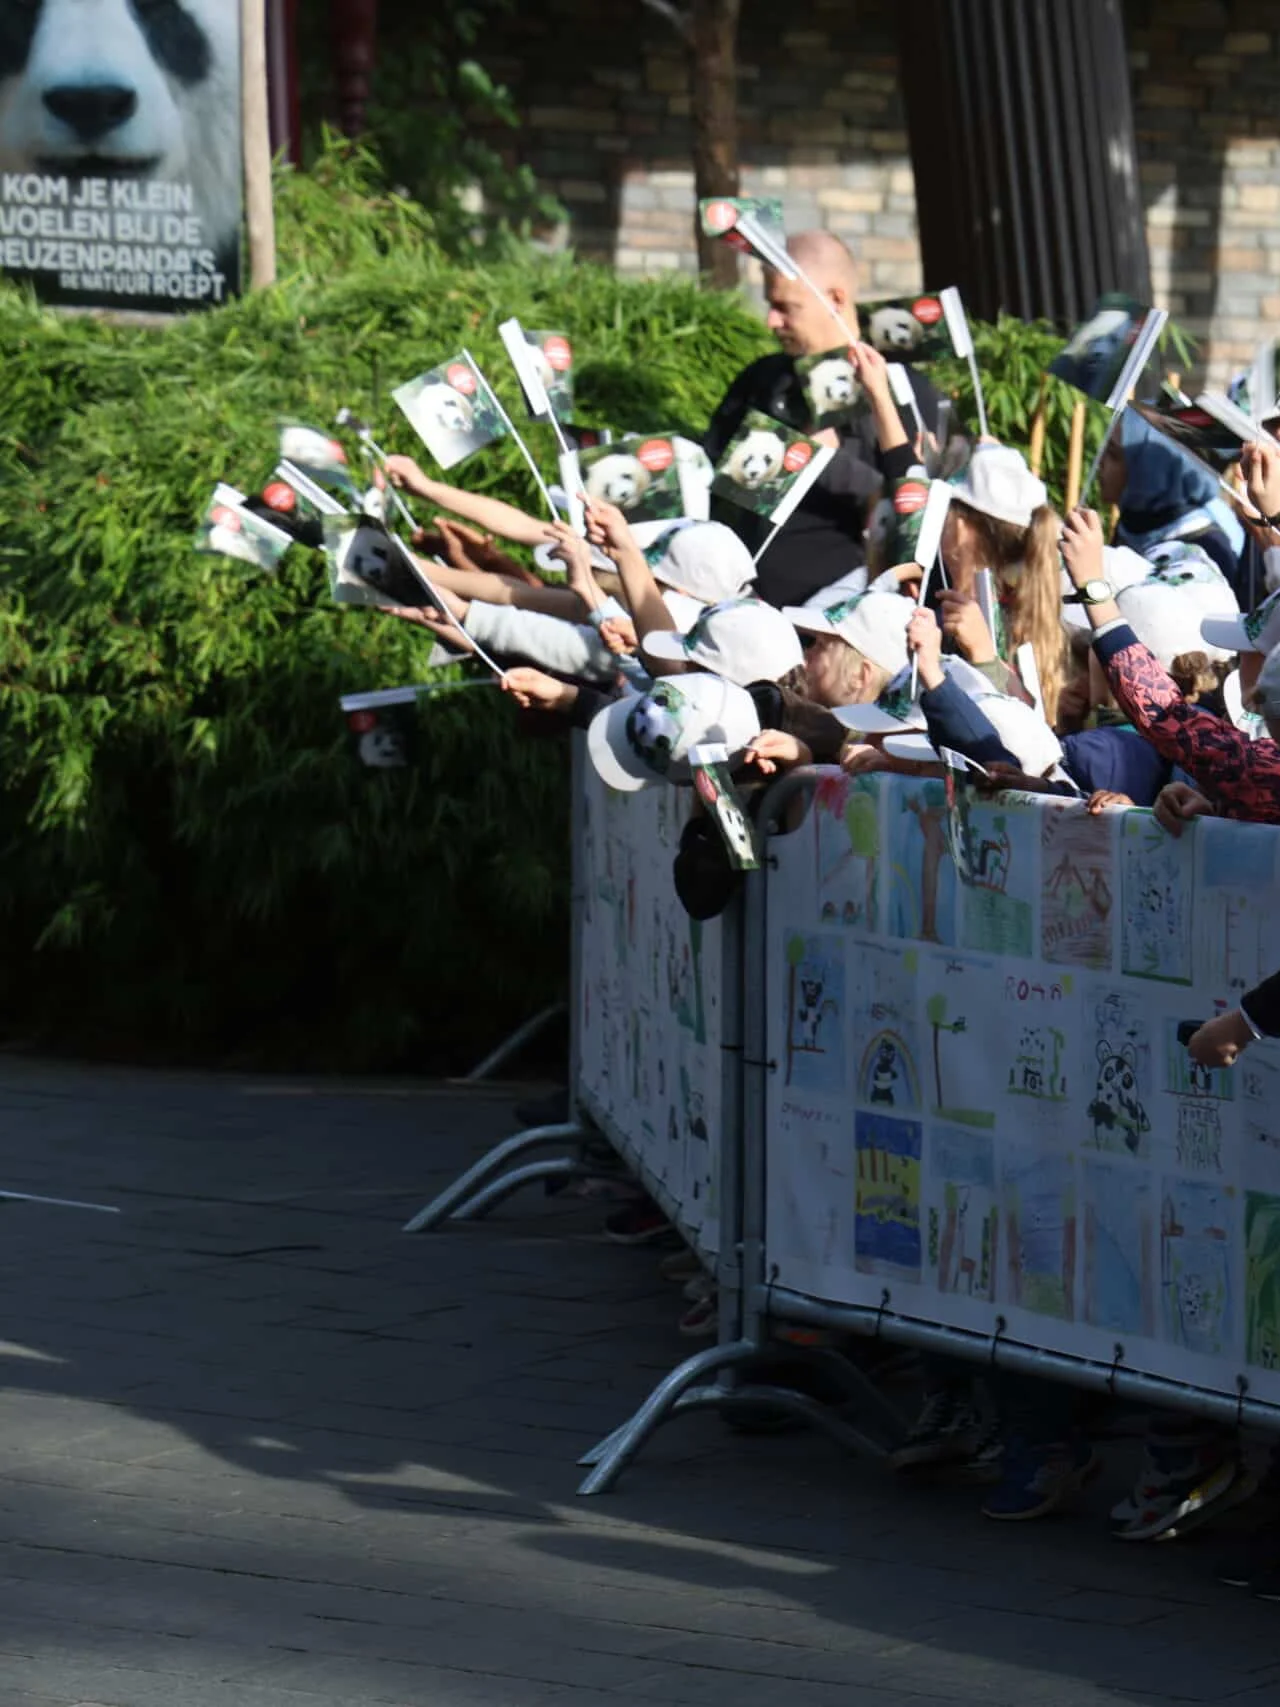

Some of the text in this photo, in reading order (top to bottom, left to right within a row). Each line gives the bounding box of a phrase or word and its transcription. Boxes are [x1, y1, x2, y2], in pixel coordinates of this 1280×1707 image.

[3, 174, 193, 212] KOM JE KLEIN
[0, 205, 201, 246] VOELEN BIJ DE
[81, 273, 150, 296] NATUUR
[153, 274, 225, 300] ROEPT
